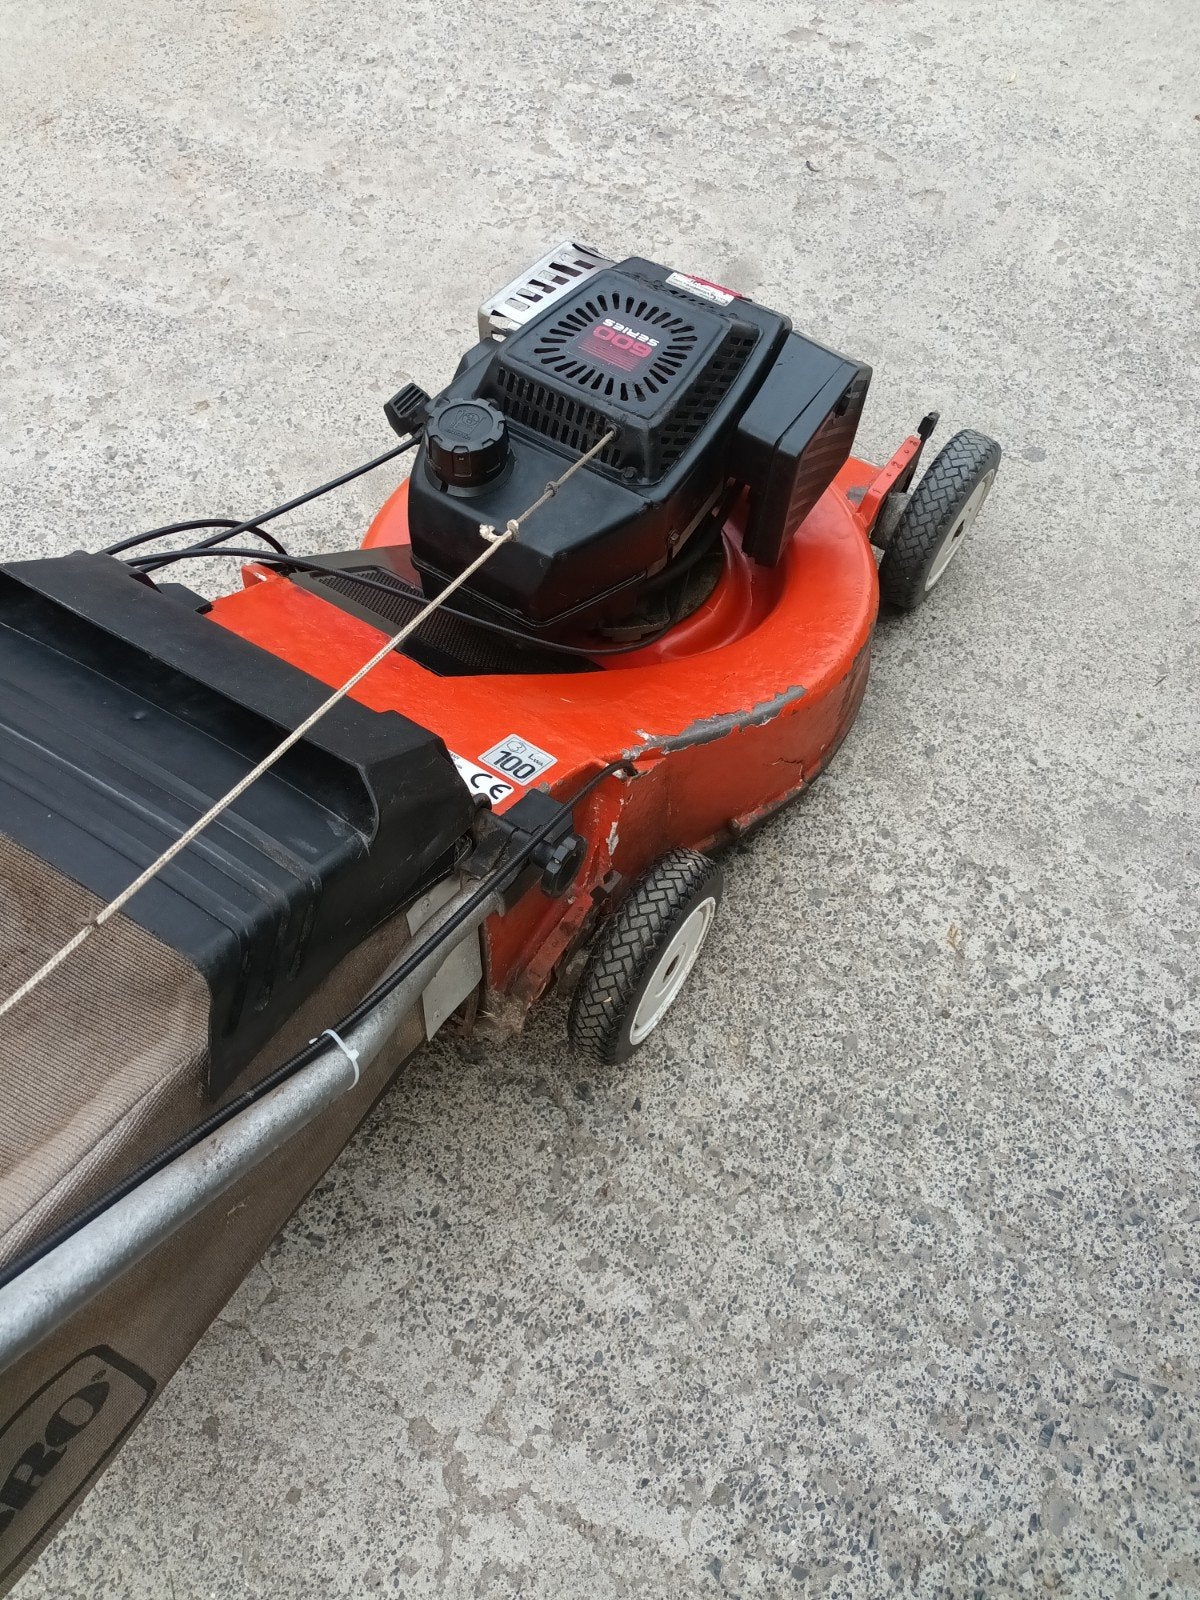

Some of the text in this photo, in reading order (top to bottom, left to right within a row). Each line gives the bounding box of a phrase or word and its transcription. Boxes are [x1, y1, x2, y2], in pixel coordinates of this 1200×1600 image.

[593, 325, 653, 358] 600
[602, 318, 660, 347] SERIES
[493, 750, 536, 779] 100
[470, 773, 512, 800] CE
[0, 1381, 110, 1535] RO
